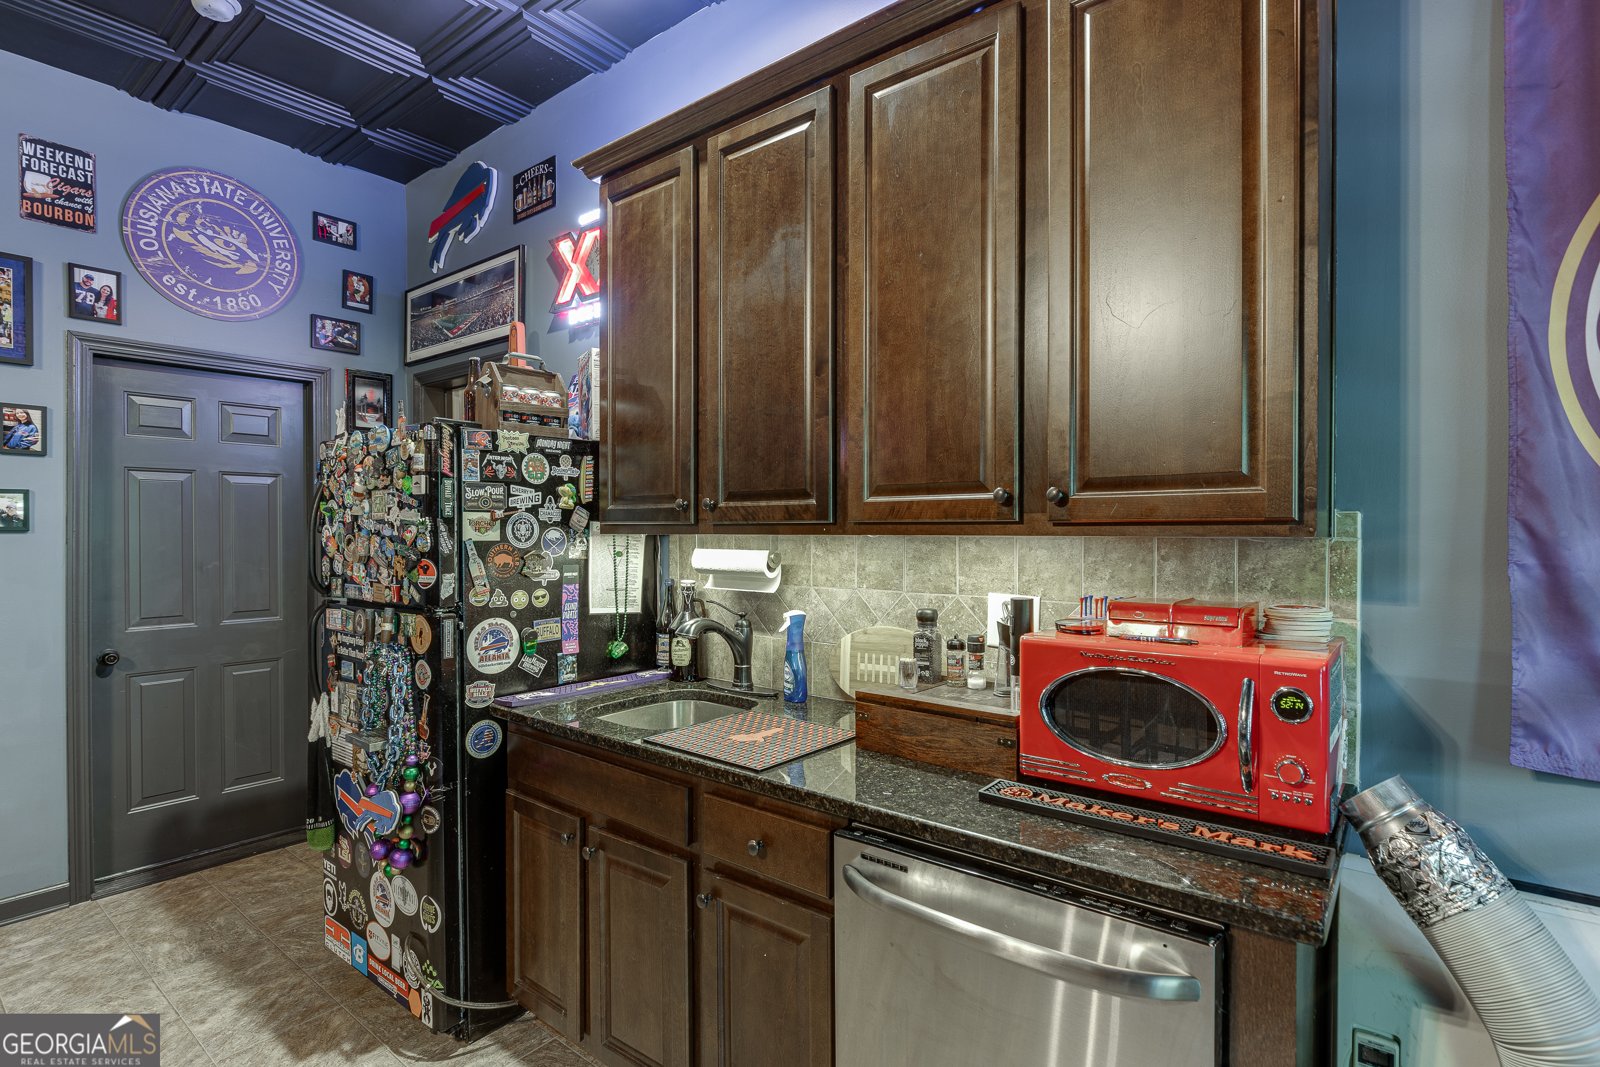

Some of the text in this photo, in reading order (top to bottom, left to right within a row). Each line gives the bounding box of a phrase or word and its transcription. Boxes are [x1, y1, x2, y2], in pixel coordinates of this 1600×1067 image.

[22, 141, 94, 171] WEEKEND
[22, 155, 94, 184] FORECAST
[520, 164, 548, 186] CHEERS
[47, 177, 93, 198] Cigars
[54, 198, 83, 211] chance
[84, 203, 94, 214] of
[74, 196, 94, 206] with
[22, 199, 95, 226] BOURBON
[138, 176, 292, 297] LOUISIANA STATE UNIVERSITY
[75, 288, 96, 305] 78
[214, 293, 262, 312] 1860
[444, 480, 453, 516] BUFFALO TRACE
[465, 486, 504, 499] SLOW POUR
[512, 486, 529, 494] CHERRY
[510, 494, 540, 506] BREWING
[488, 544, 514, 566] SOUTHERN
[479, 652, 511, 663] ATLANTA
[1038, 792, 1318, 862] Maker's Mark
[324, 859, 336, 875] YETI
[382, 968, 394, 982] LOCAL
